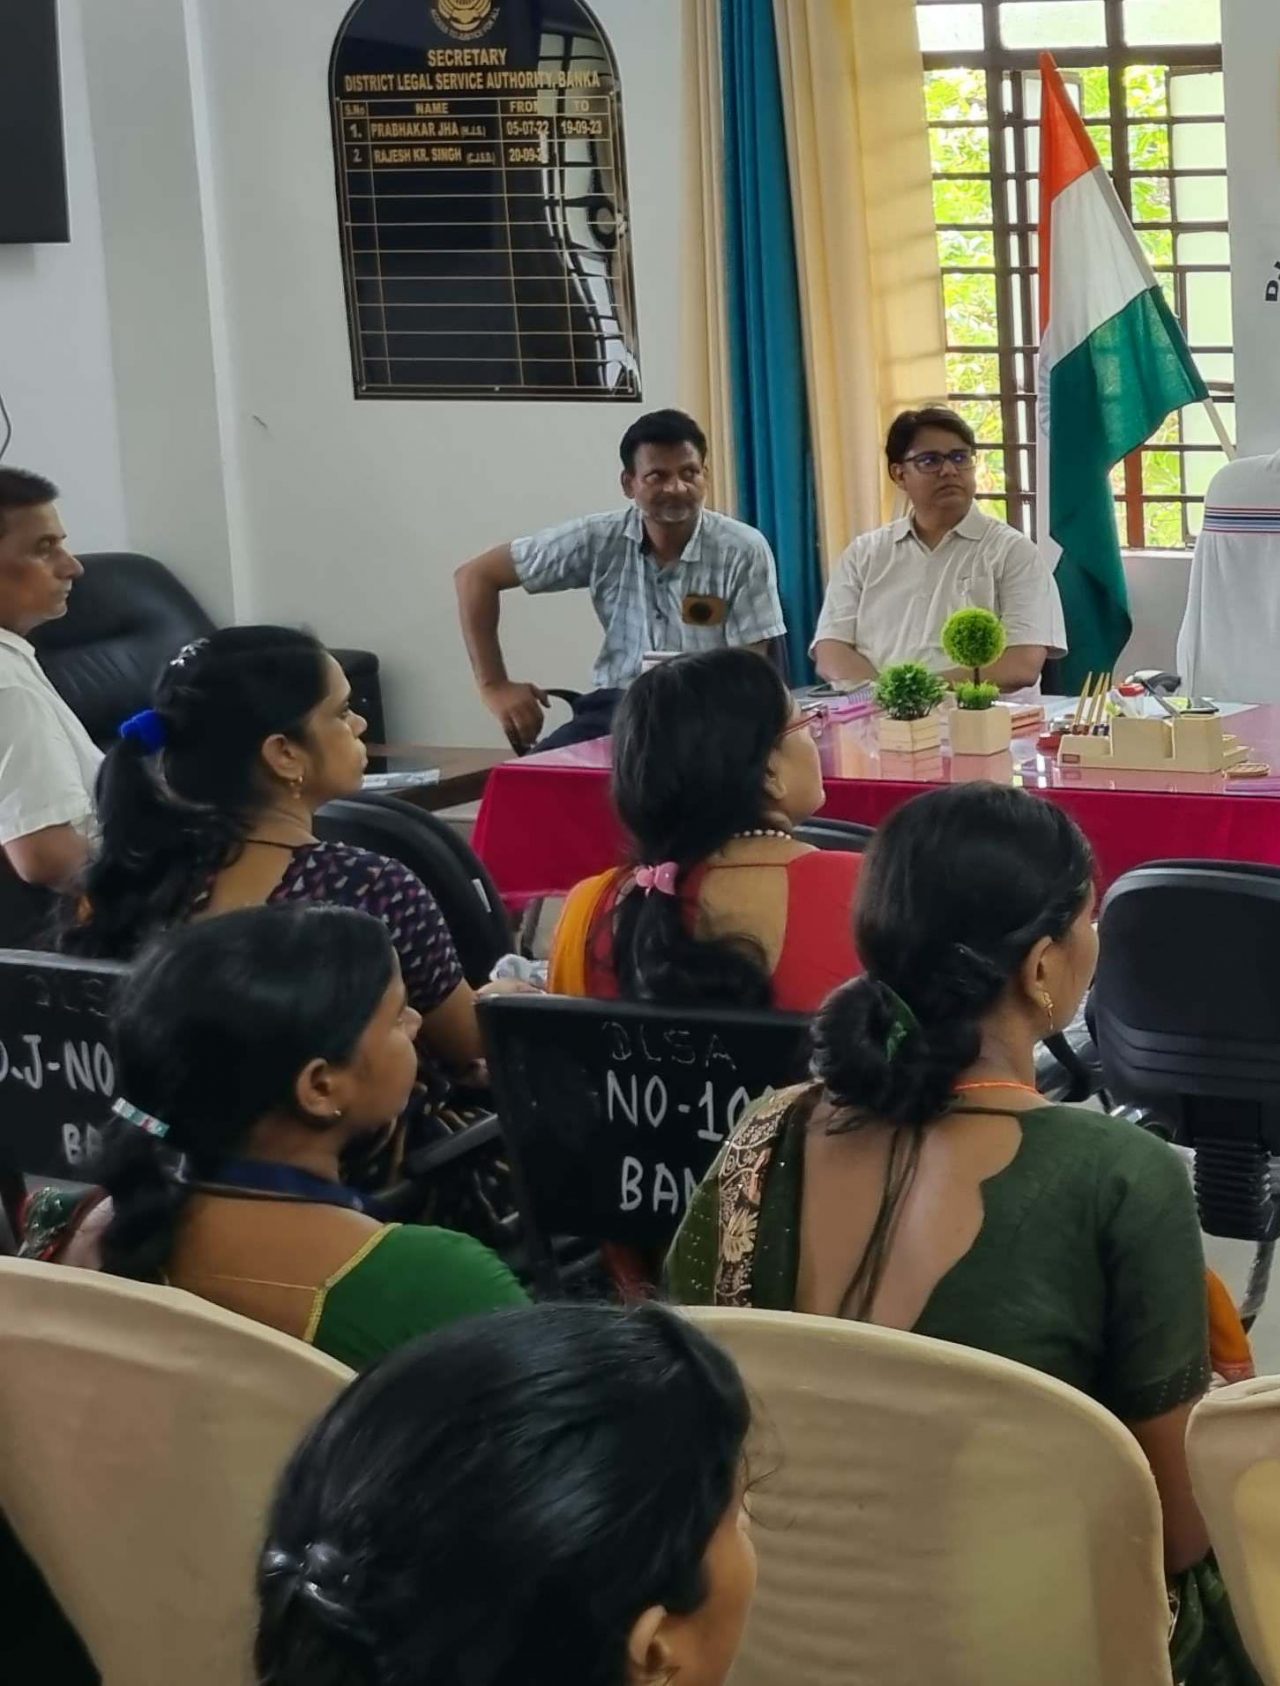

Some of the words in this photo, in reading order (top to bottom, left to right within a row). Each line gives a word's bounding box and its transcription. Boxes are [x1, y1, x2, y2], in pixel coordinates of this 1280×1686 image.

[427, 48, 507, 67] SECRETARY
[344, 73, 395, 92] DISTRICT
[398, 73, 433, 91] LEGAL
[435, 72, 484, 90] SERVICE
[559, 70, 600, 88] BANKA
[415, 102, 449, 115] NAME
[574, 100, 590, 113] TO
[370, 122, 436, 138] PRABHAKAR
[438, 121, 459, 137] JHA
[506, 120, 550, 136] 05-07-22
[561, 120, 602, 135] 19-09-23
[373, 148, 411, 164] RAJESH
[431, 147, 462, 162] SINGH
[509, 148, 547, 163] 20-09-2
